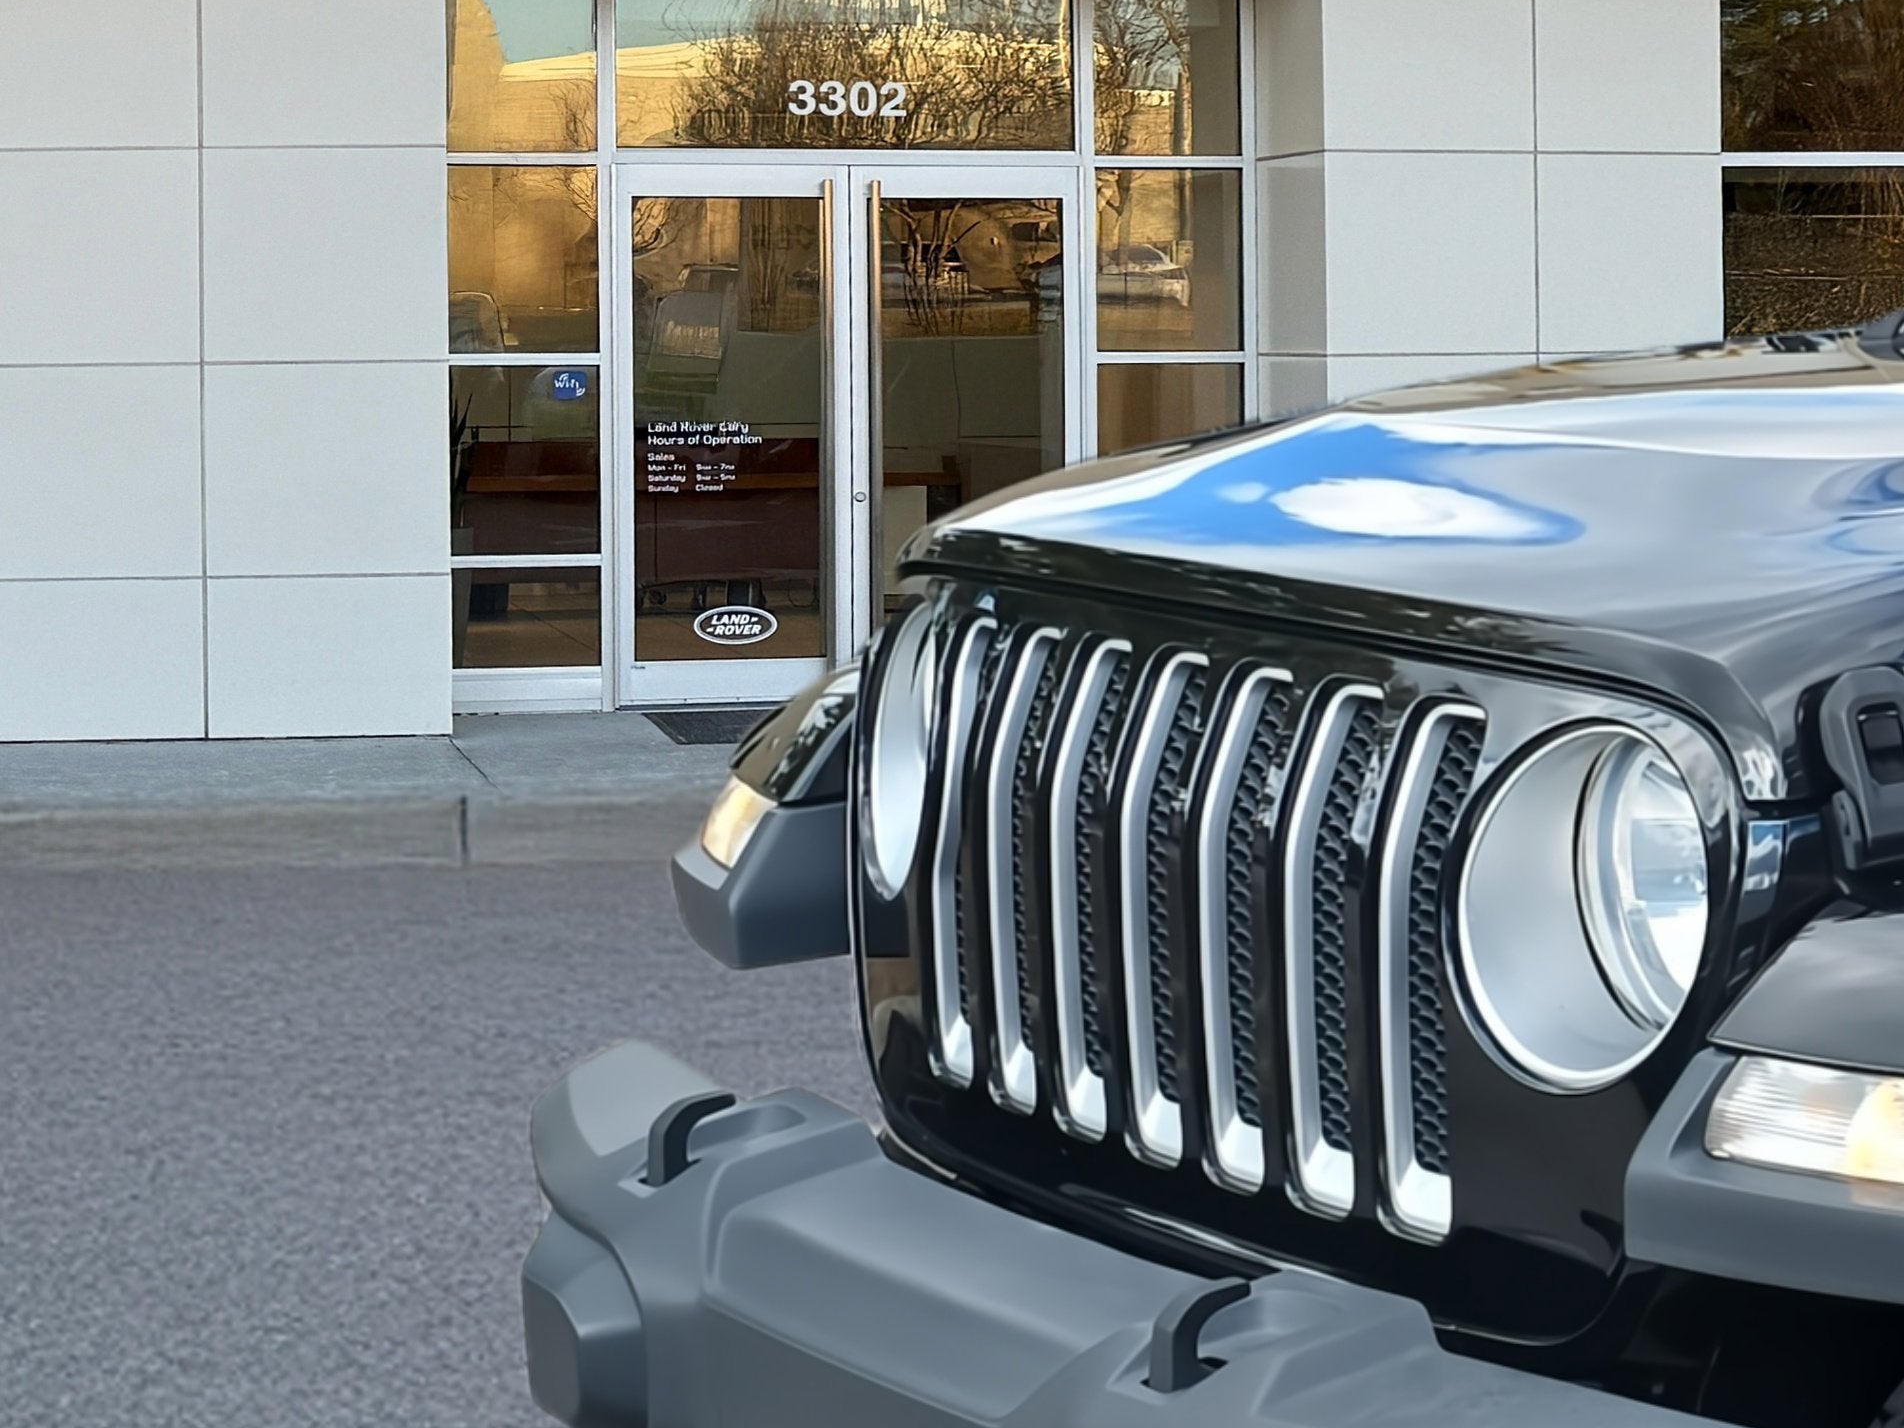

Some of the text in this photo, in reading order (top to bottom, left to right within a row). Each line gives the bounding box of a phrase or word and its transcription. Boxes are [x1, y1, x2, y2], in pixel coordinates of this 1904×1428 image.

[788, 79, 907, 117] 3302
[648, 422, 677, 432] Land
[648, 434, 762, 446] Hours of Operation
[647, 452, 675, 461] Sales
[711, 614, 750, 625] LAND
[714, 624, 762, 635] ROVER
